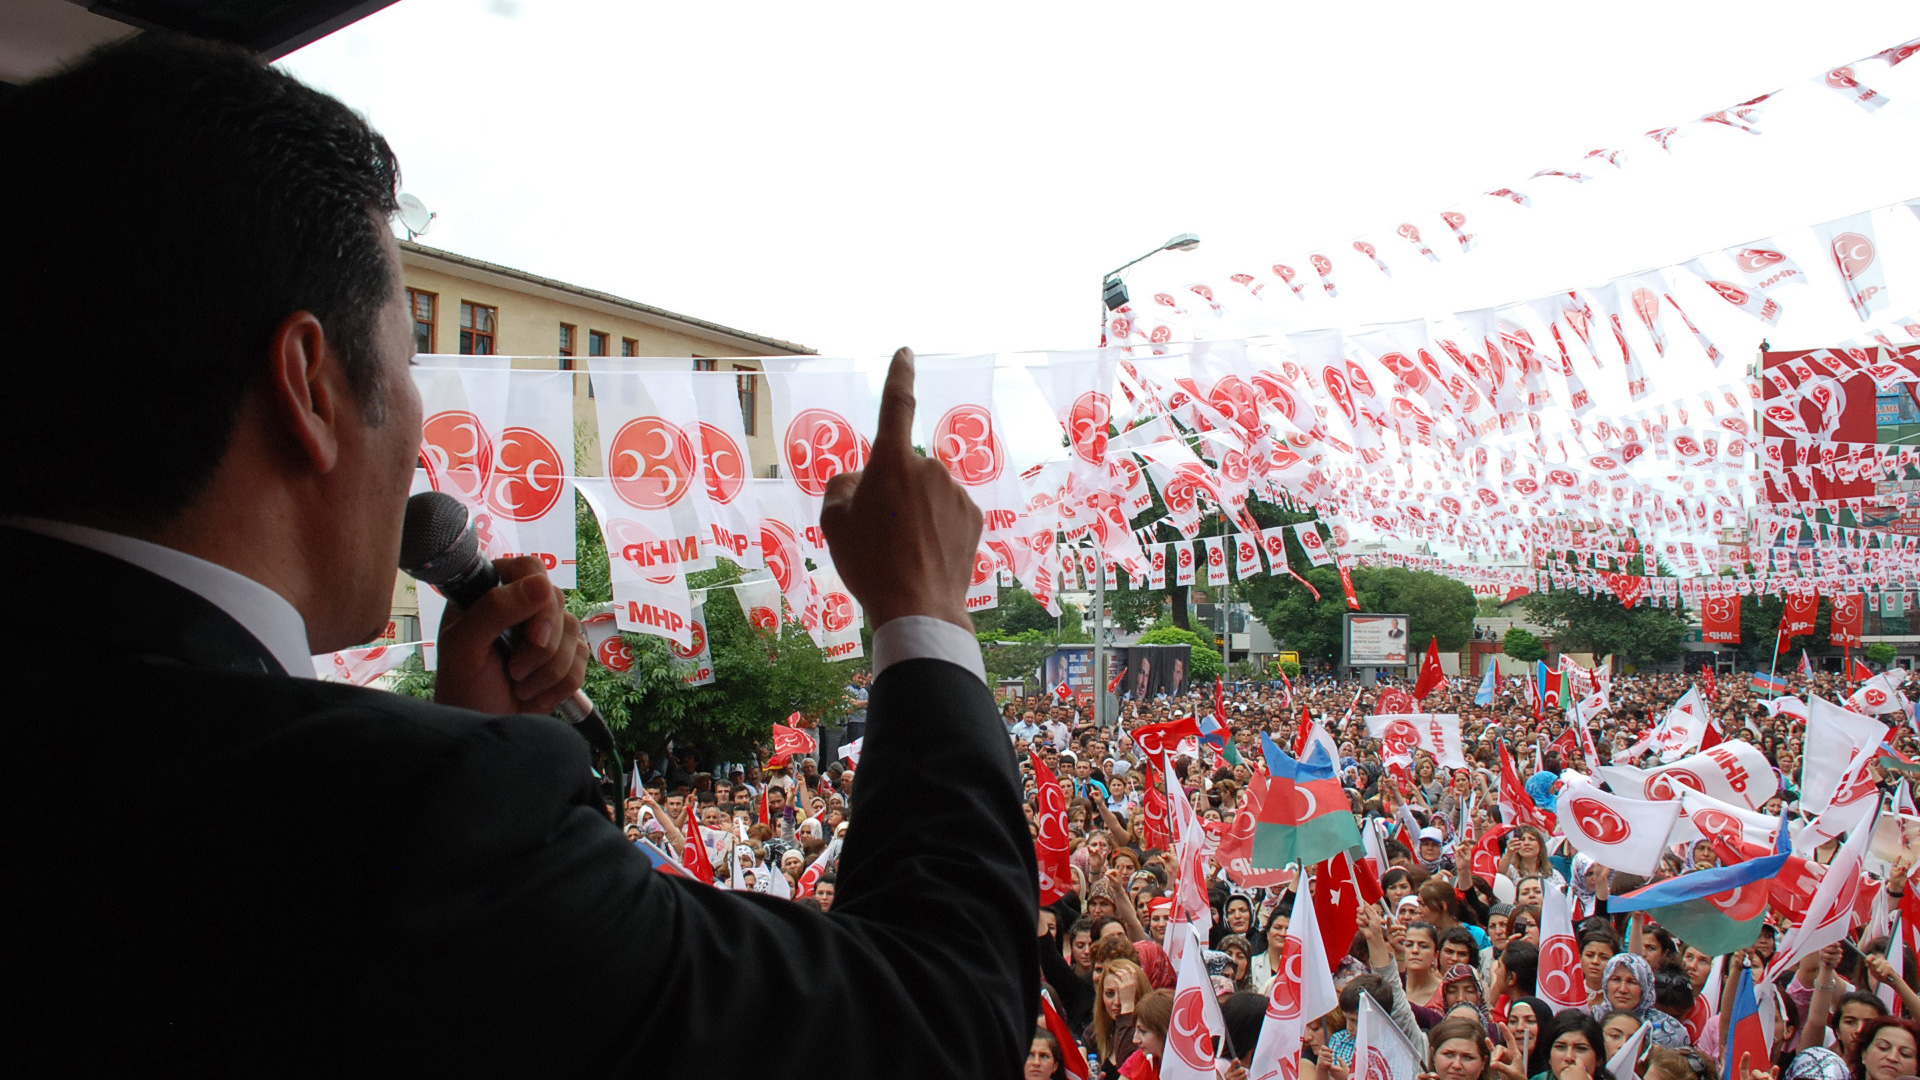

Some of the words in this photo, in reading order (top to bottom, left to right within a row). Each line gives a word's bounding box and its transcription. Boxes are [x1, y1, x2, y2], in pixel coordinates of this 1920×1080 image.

[1758, 269, 1797, 289] MHP
[1856, 285, 1879, 310] HP
[1608, 473, 1628, 482] MHP
[1134, 494, 1151, 509] HP
[1271, 562, 1284, 570] HP
[628, 601, 684, 633] MHP
[827, 641, 856, 658] MHP
[1430, 721, 1445, 754] MHP
